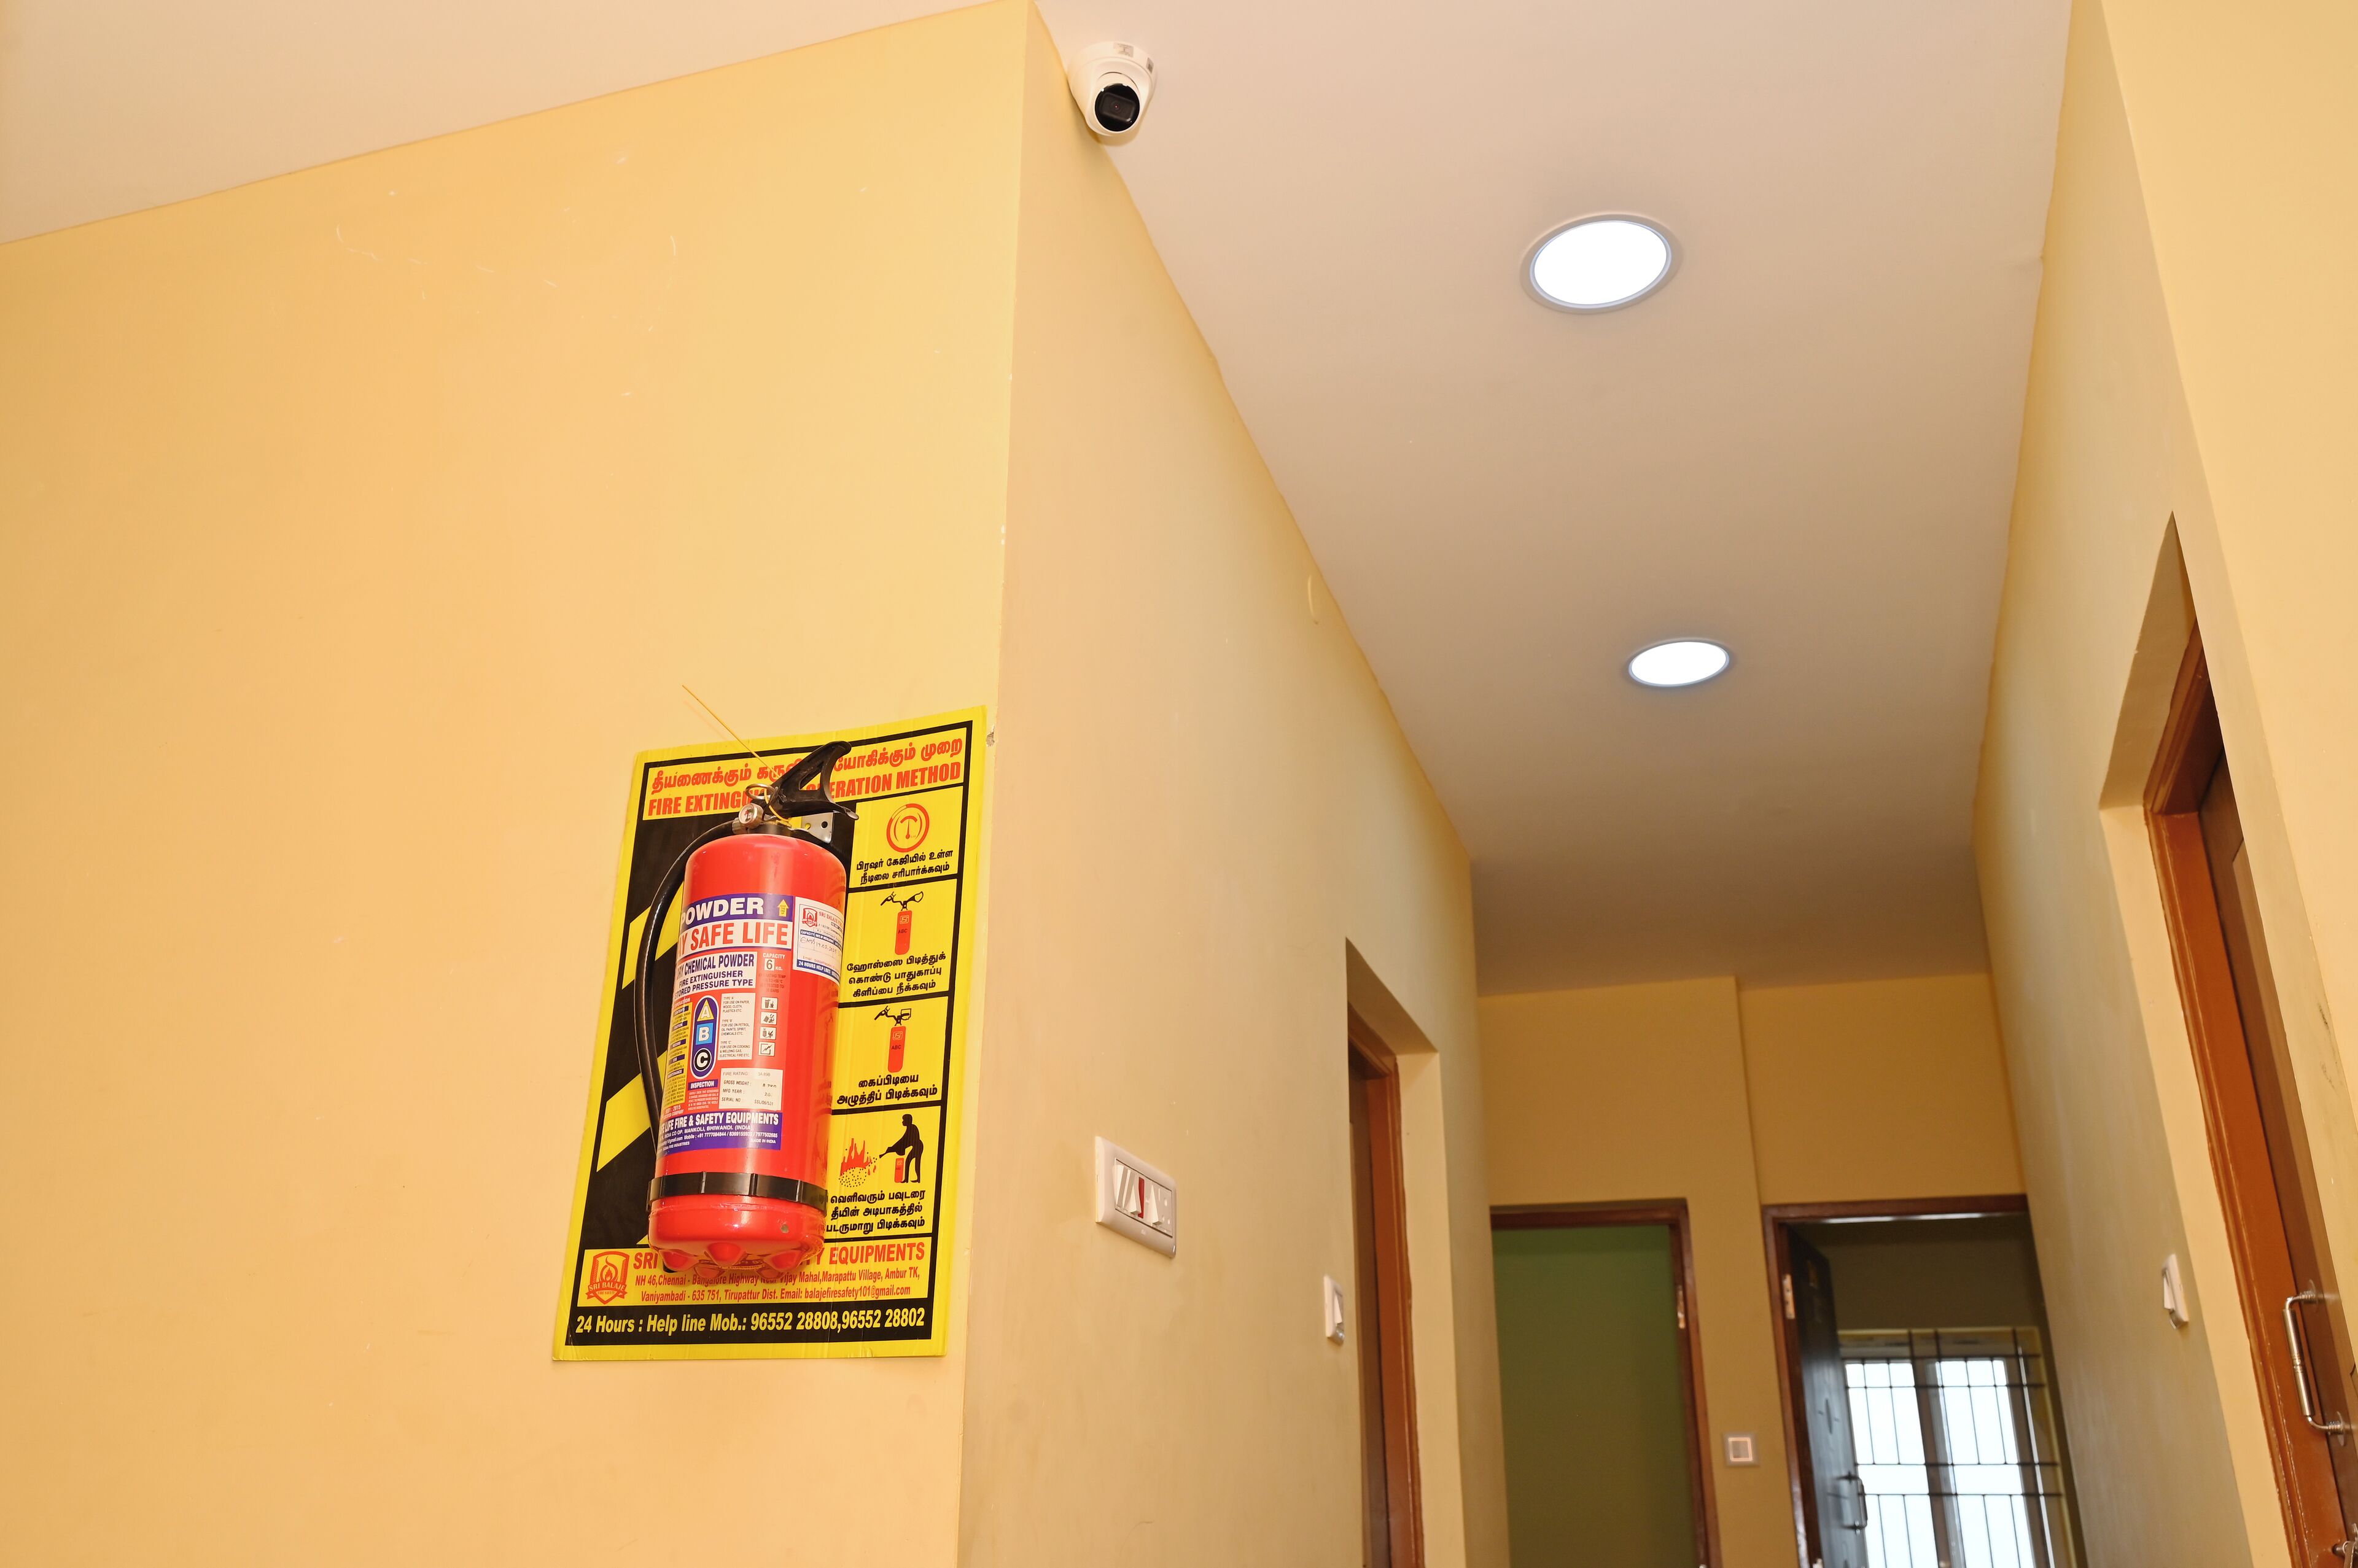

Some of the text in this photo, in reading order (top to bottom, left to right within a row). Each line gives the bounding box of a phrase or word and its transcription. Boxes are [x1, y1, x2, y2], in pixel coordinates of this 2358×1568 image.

[651, 763, 752, 794] தீயணைக்கும்
[920, 738, 963, 761] முறை
[648, 797, 682, 816] FIRE
[685, 788, 763, 812] EXTINGU
[896, 761, 961, 789] METHOD
[857, 849, 954, 871] பிரஷர் கேஜியில் உள்ள
[860, 862, 950, 885] நீடிலை சரிபார்க்கவும்
[682, 897, 764, 925] POWDER
[690, 922, 734, 951] SAFE
[742, 922, 788, 945] LIFE
[684, 955, 716, 976] CHEMICAL
[718, 954, 754, 968] POWDER
[766, 959, 772, 970] 6
[847, 960, 903, 973] ஹோஸ்ஸை
[906, 952, 946, 965] பிடித்துக்
[679, 970, 743, 988] FIRE EXTINGUISHER
[849, 972, 891, 985] கொண்டு
[894, 966, 942, 981] பாதுகாப்பு
[692, 980, 729, 992] PRESSURE
[853, 979, 936, 998] கிளிப்பை நீக்கவும்
[701, 1006, 711, 1019] A
[698, 1027, 710, 1042] B
[696, 1052, 709, 1068] C
[690, 1081, 714, 1089] INSPECTION
[858, 1074, 919, 1088] கைப்பிடியை
[837, 1084, 938, 1107] அழுத்திப் பிடிக்கவும்
[665, 1119, 674, 1133] LIFE
[674, 1116, 687, 1129] FIRE
[688, 1115, 694, 1127] &
[696, 1112, 724, 1125] SAFETY
[726, 1112, 779, 1125] EQUIPMENTS
[830, 1190, 926, 1203] வெளிவரும் பவுடரை
[831, 1202, 923, 1221] தீயின் அடிபாகத்தில்
[826, 1216, 925, 1235] படருமாறு பிடிக்கவும்
[633, 1252, 658, 1270] SRI
[829, 1242, 925, 1265] EQUIPMENTS
[589, 1282, 625, 1291] SRI BALAJE
[636, 1275, 646, 1286] NH
[648, 1274, 687, 1287] 46,Chennai
[729, 1273, 759, 1287] Highway
[798, 1270, 857, 1284] Mahal,Marapattu
[858, 1269, 883, 1282] Village,
[885, 1268, 906, 1279] Ambur
[909, 1267, 920, 1278] TK,
[641, 1290, 686, 1304] Vaniyambadi
[692, 1290, 705, 1300] 635
[707, 1290, 722, 1302] 751,
[724, 1289, 760, 1303] Tirupattur
[762, 1289, 778, 1299] Dist.
[780, 1288, 803, 1299] Email:
[804, 1286, 911, 1301] balajefiresafety101@gmail.com
[575, 1308, 925, 1336] 24 Hours : Help line Mob.: 96552 28808,96552 28802
